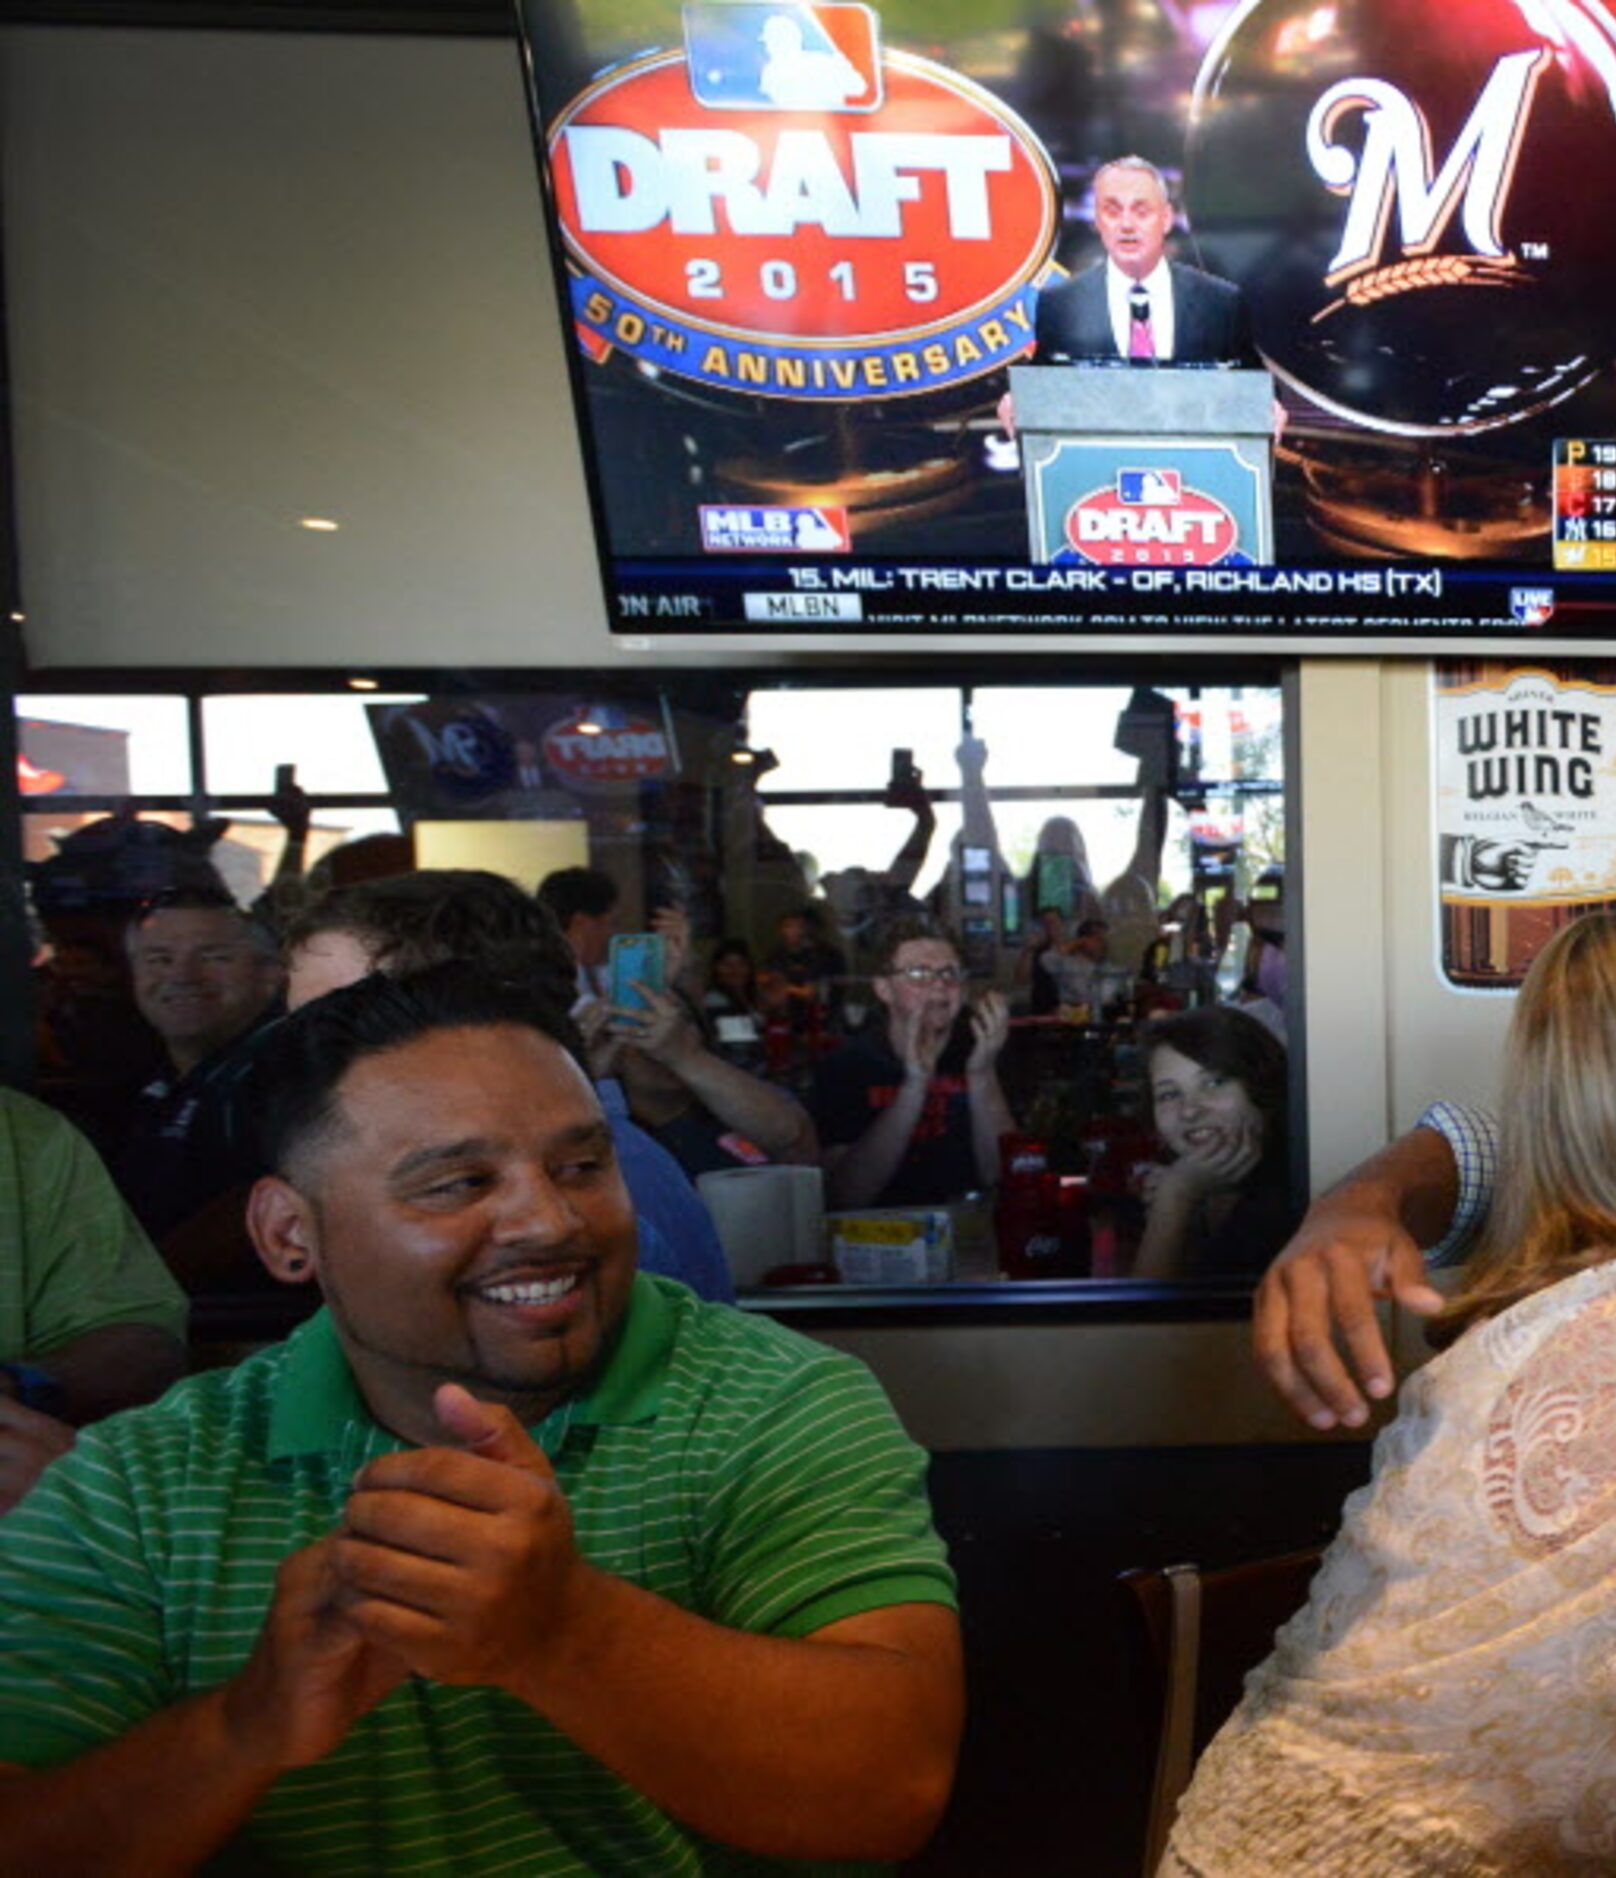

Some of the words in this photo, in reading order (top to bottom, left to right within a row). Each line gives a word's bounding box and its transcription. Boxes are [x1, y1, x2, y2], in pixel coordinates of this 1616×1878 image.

[1306, 45, 1554, 287] M
[1521, 243, 1548, 259] TM
[564, 126, 1011, 240] DRAFT
[685, 260, 939, 302] 2015
[583, 293, 686, 353] 50TH
[703, 301, 1031, 388] ANNIVERSARY
[706, 510, 792, 531] MLB
[1078, 508, 1224, 543] DRAFT
[1592, 521, 1616, 538] 16
[708, 533, 793, 547] NETWORK
[1111, 549, 1194, 562] 2015
[788, 567, 827, 589] 15.
[832, 568, 894, 589] MIL:
[898, 569, 1000, 590] TRENT
[1005, 570, 1107, 591] CLARK
[1131, 570, 1181, 594] OF,
[1186, 571, 1333, 592] RICHLAND
[1338, 571, 1381, 592] HS
[656, 595, 701, 616] AIR
[767, 596, 839, 617] MLBN
[1457, 709, 1602, 754] WHITE
[1467, 754, 1594, 801] WING
[1464, 810, 1518, 821] BELGIAN
[1553, 810, 1597, 821] WHITE
